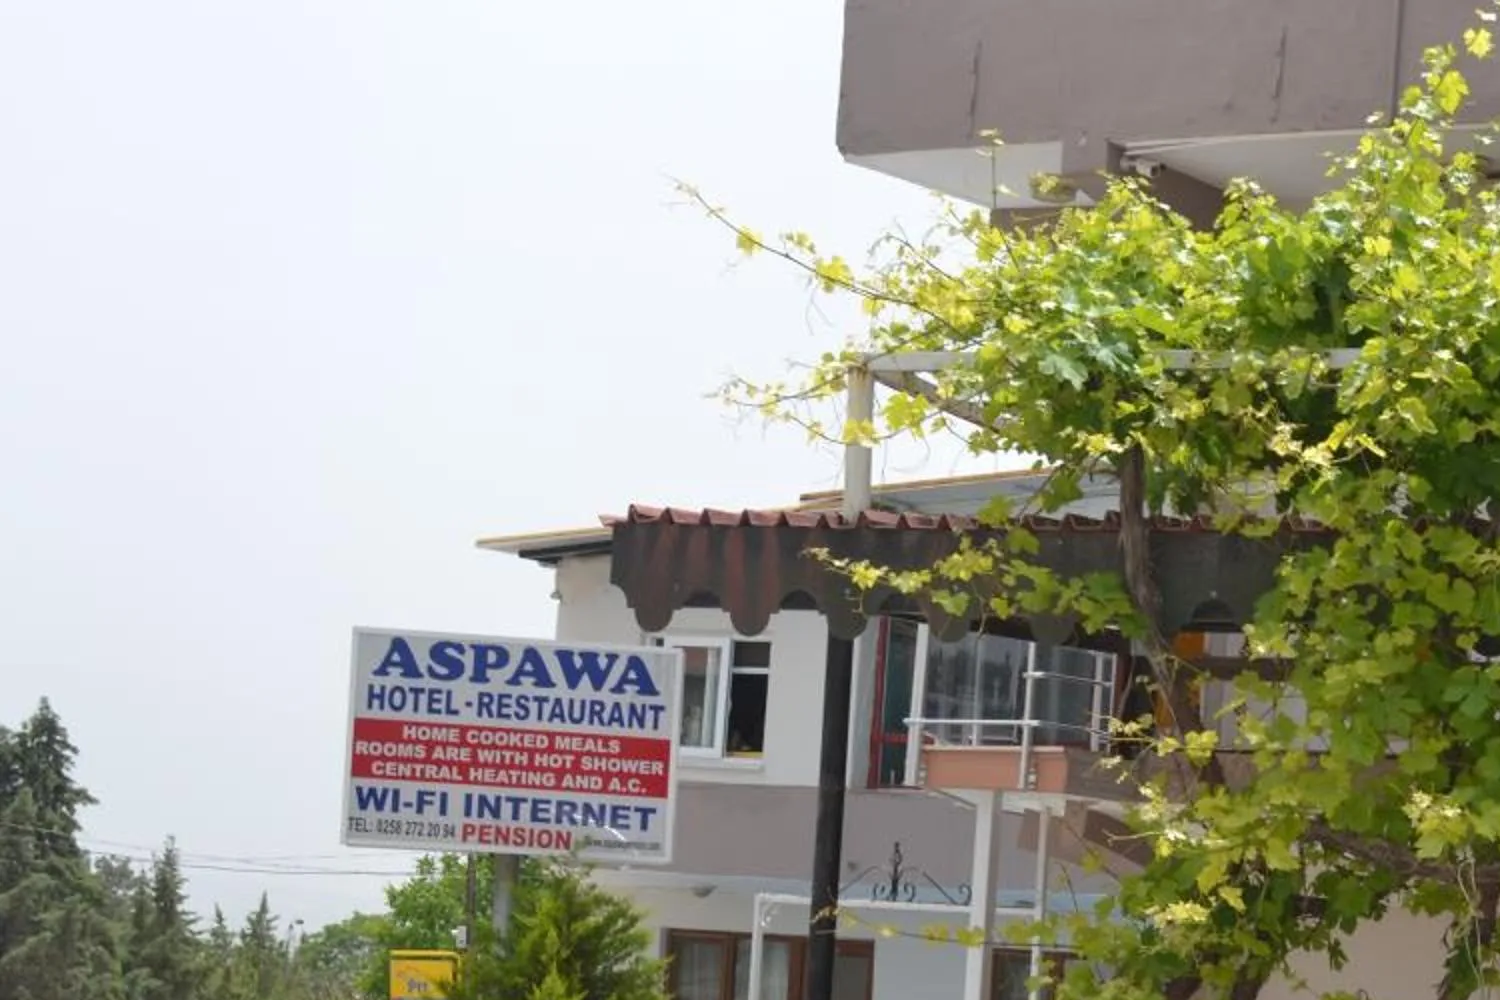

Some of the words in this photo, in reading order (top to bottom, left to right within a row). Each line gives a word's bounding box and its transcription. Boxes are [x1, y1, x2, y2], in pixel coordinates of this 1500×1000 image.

[372, 637, 660, 697] ASPAWA
[402, 726, 460, 742] HOME
[466, 729, 549, 748] COOKED
[554, 736, 620, 754] MEALS
[355, 742, 427, 759] ROOMS
[432, 746, 473, 763] ARE
[478, 750, 529, 766] WITH
[535, 753, 575, 769] HOT
[579, 757, 664, 775] SHOWER
[371, 762, 462, 781] CENTRAL
[469, 770, 556, 787] HEATING
[561, 775, 603, 790] AND
[608, 779, 647, 794] A.C.
[355, 786, 448, 816] WI-FI
[464, 793, 657, 831] INTERNET
[348, 817, 374, 833] TEL:
[405, 820, 424, 837] 272
[427, 822, 441, 838] 20
[462, 822, 572, 850] PENSION
